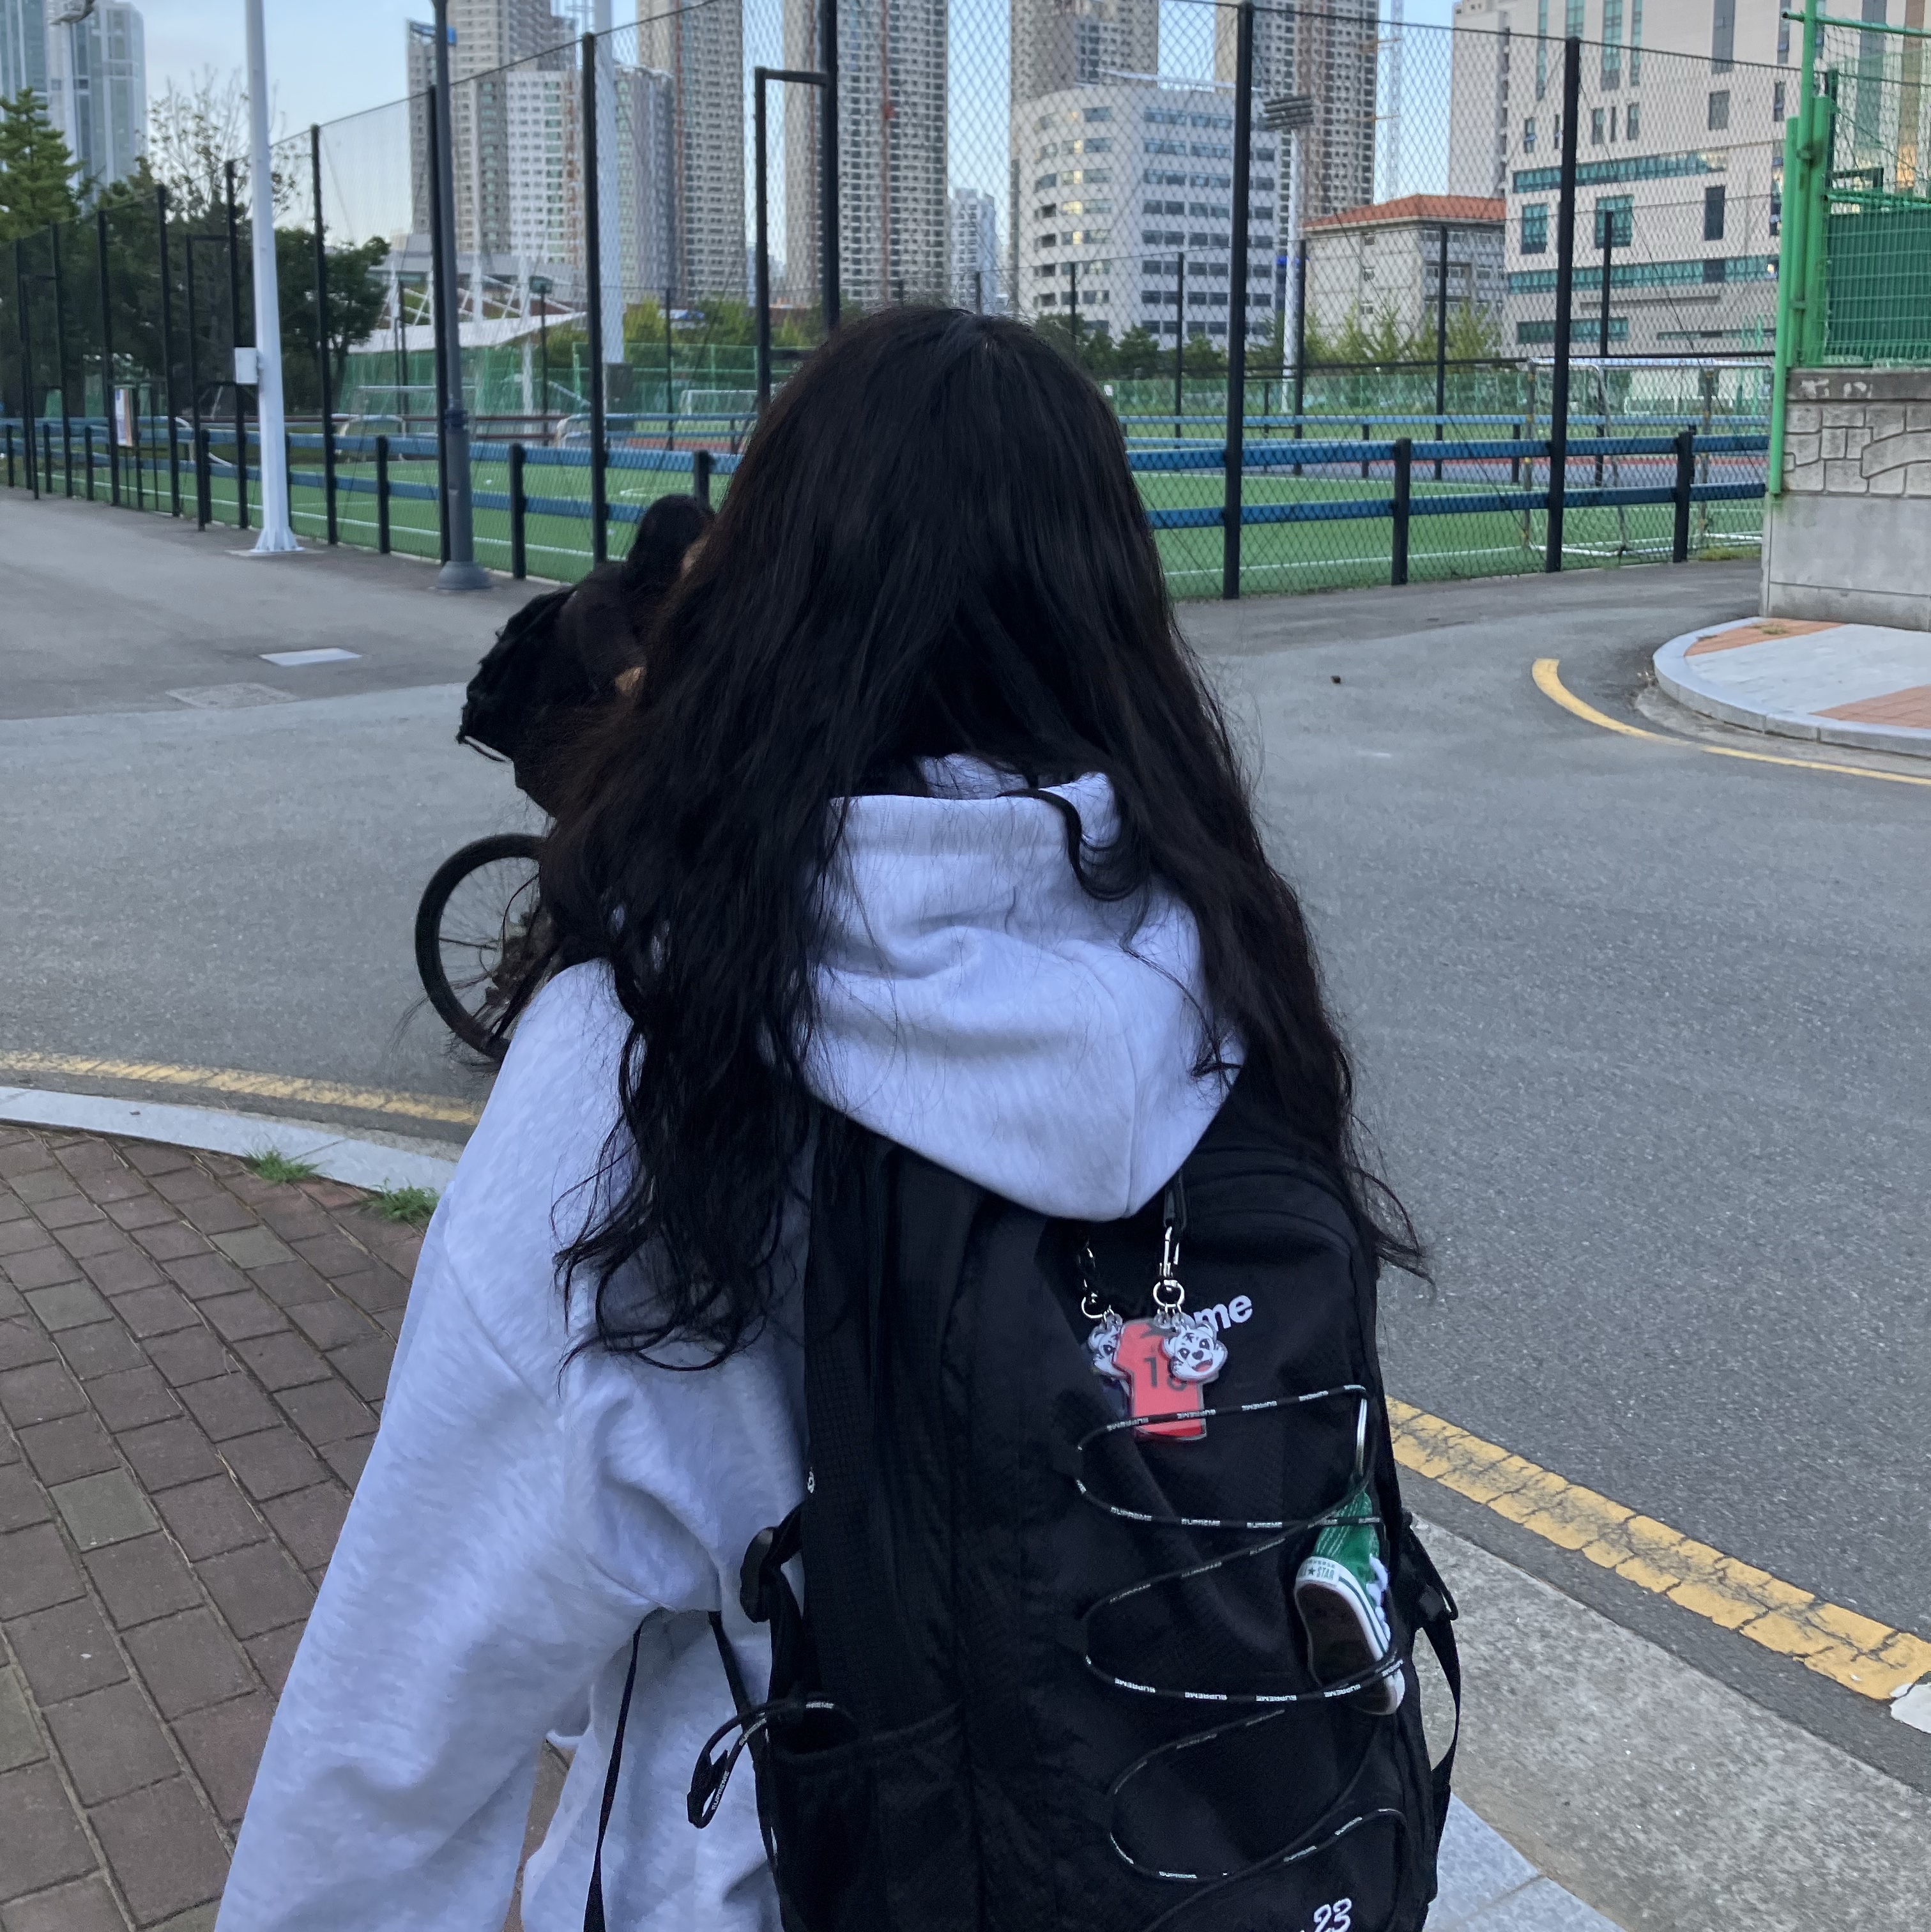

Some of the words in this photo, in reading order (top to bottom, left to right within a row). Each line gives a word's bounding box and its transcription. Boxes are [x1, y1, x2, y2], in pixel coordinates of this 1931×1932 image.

[1115, 1678, 1156, 1693] SUPREME
[1324, 1683, 1361, 1698] SUPREME
[1184, 1692, 1228, 1701] SUPREME
